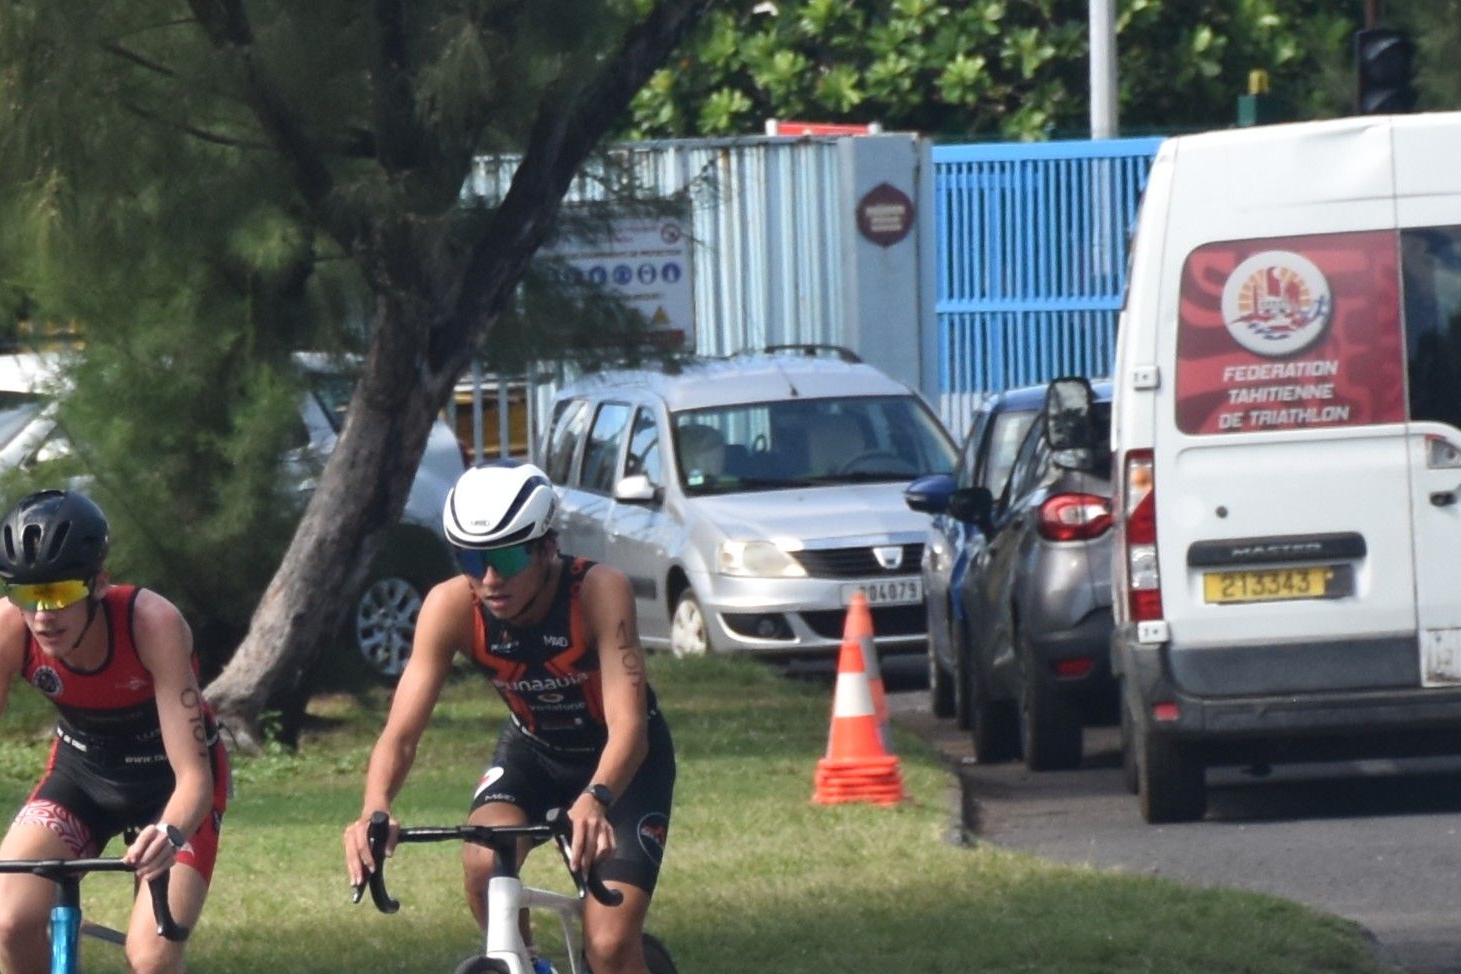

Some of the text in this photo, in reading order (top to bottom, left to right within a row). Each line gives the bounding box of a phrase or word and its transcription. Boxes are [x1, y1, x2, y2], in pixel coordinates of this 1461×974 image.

[1223, 360, 1339, 382] FEDERATION
[1228, 384, 1335, 405] TAHITIENNE
[1218, 405, 1350, 429] DE TRIATHLON
[1221, 570, 1311, 597] 213343
